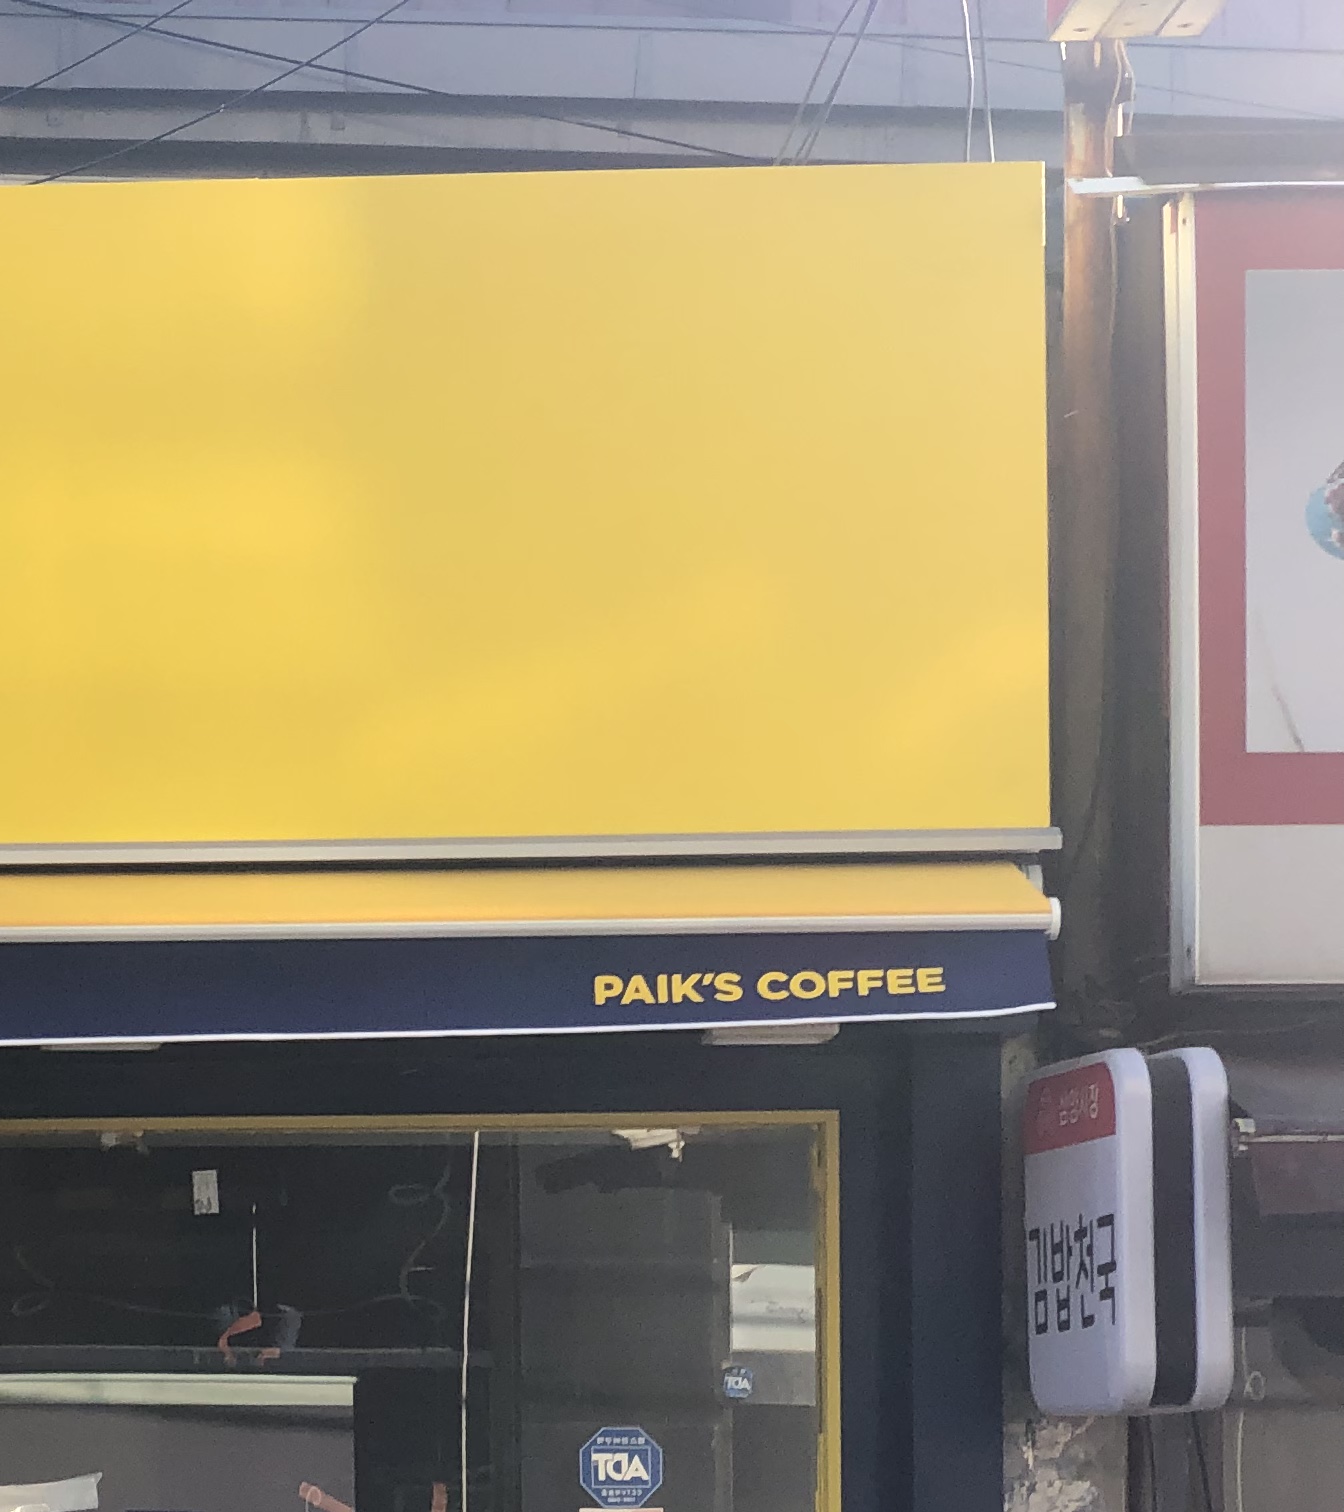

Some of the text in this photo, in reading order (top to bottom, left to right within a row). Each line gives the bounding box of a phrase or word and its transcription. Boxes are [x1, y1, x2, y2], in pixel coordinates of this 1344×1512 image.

[594, 967, 946, 1005] PAIK'S COFFEE
[1029, 1213, 1116, 1335] 김밥천국
